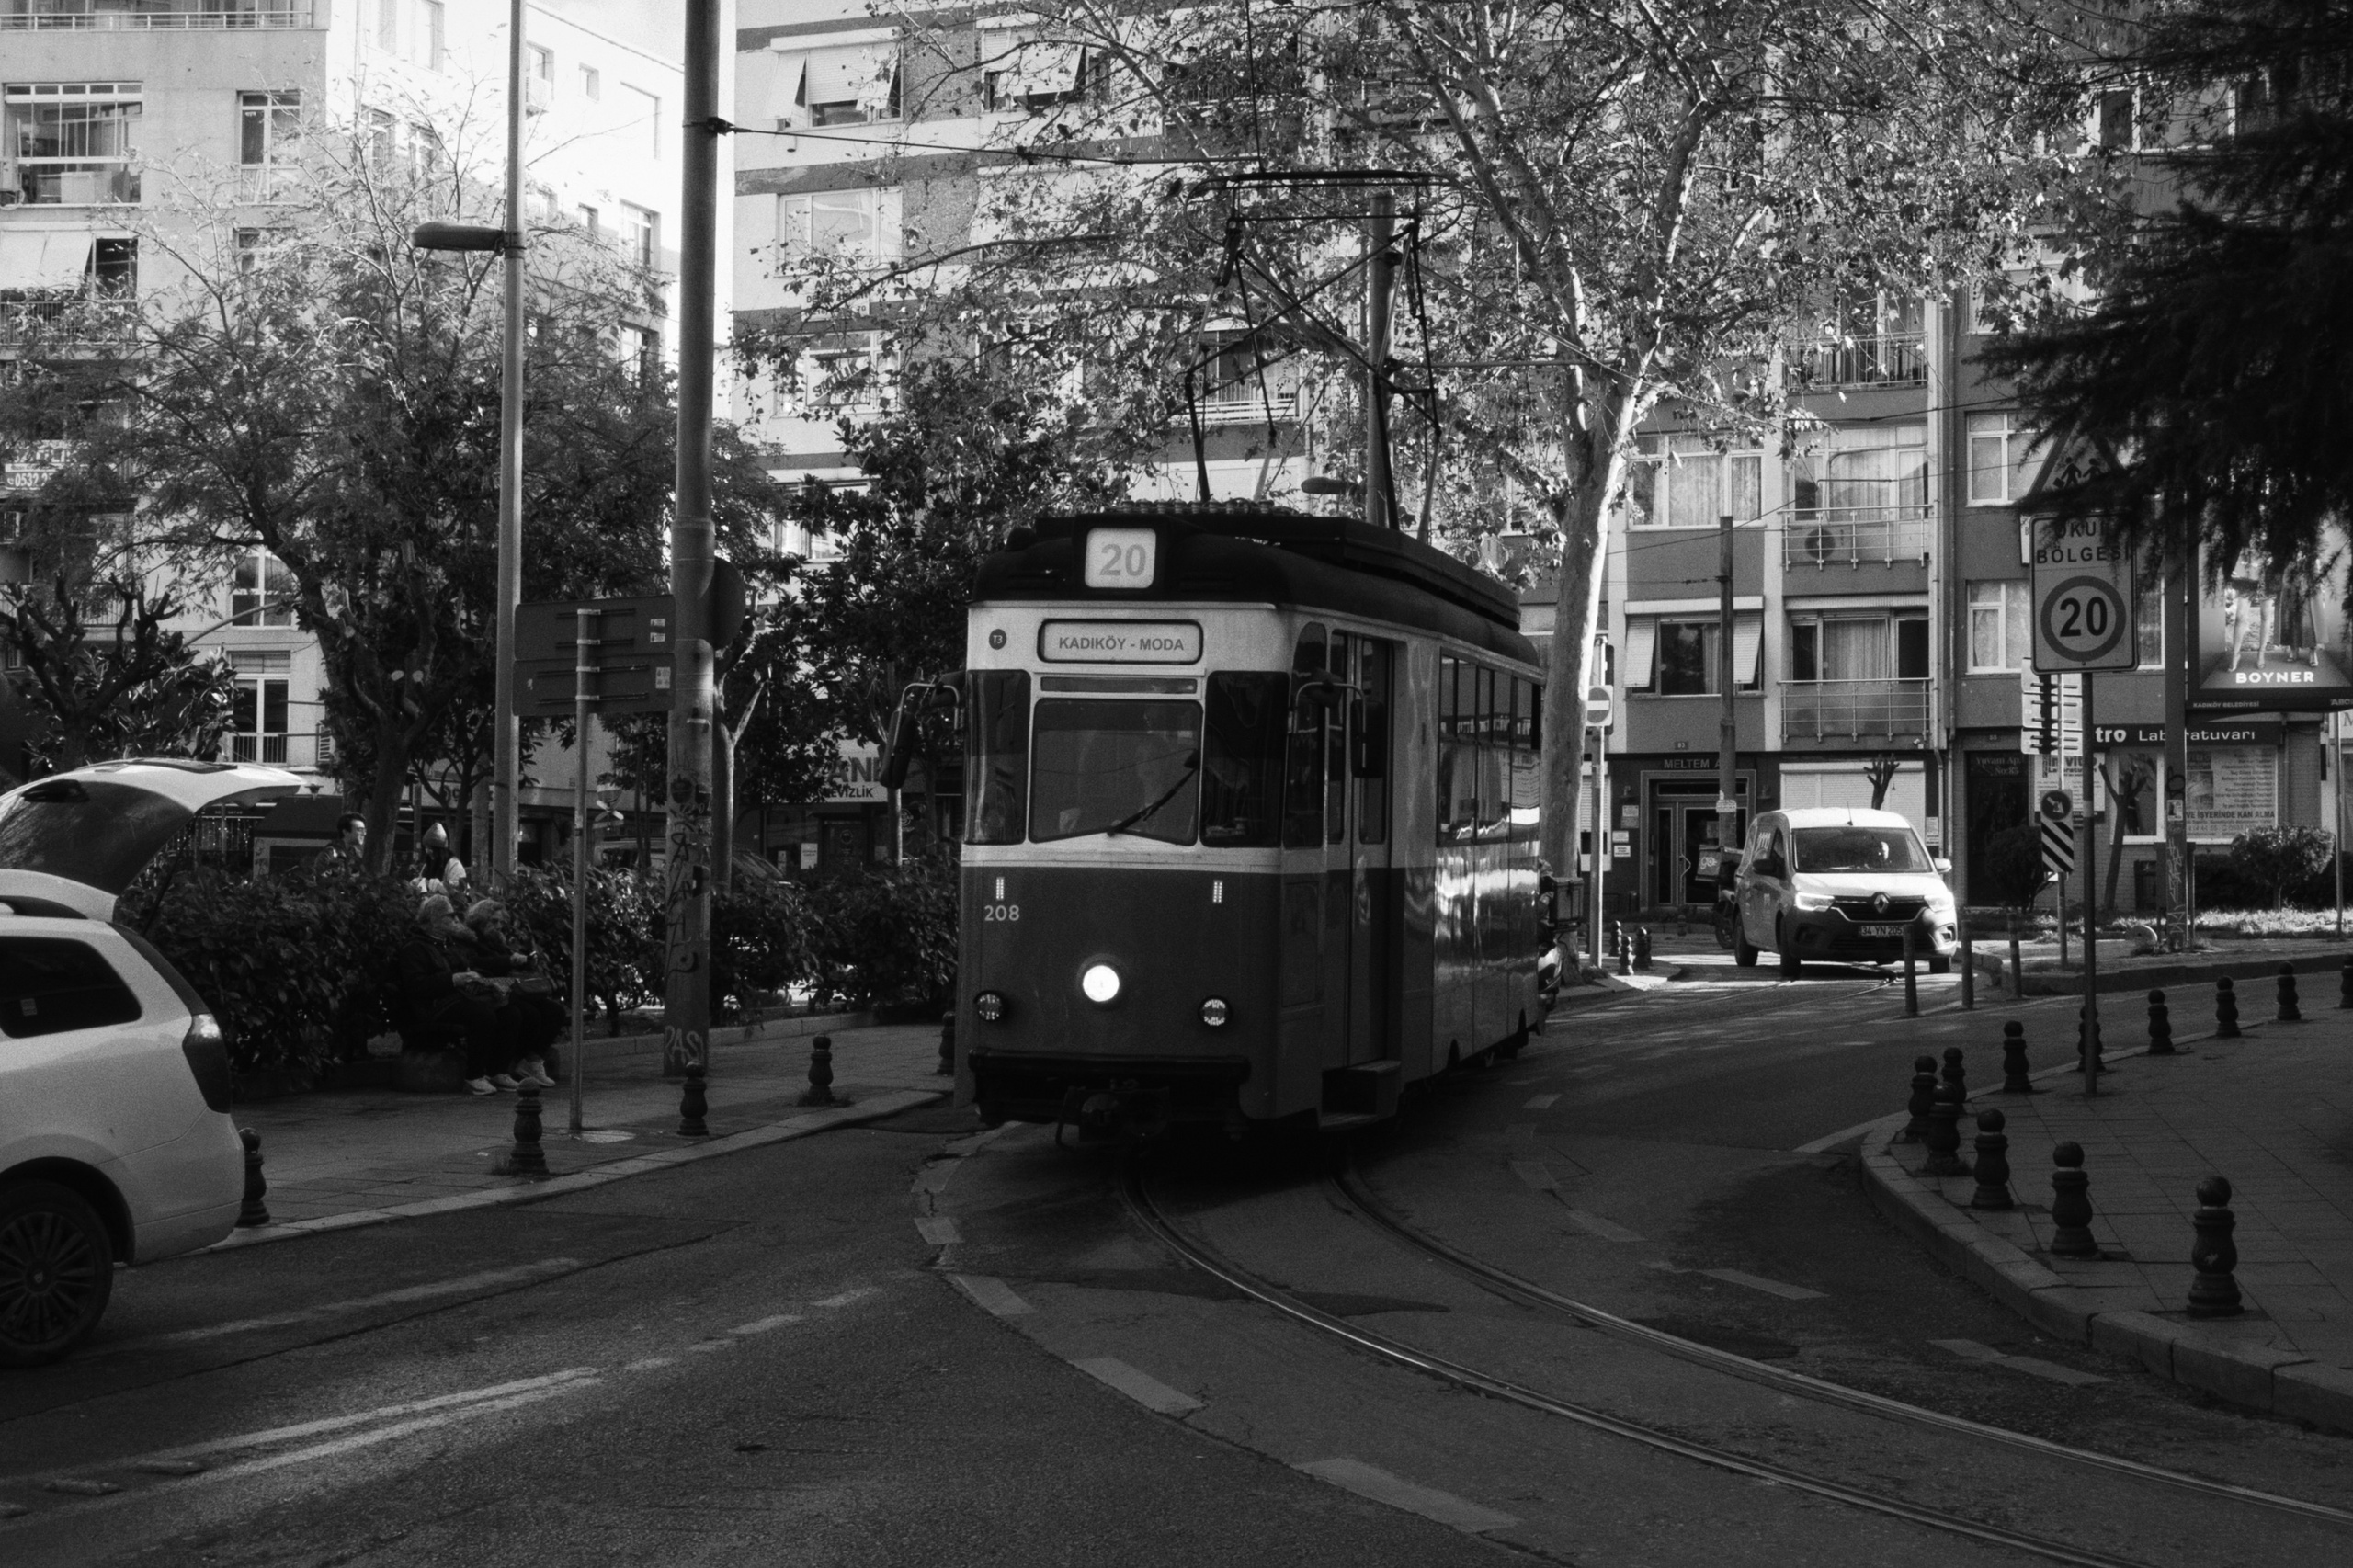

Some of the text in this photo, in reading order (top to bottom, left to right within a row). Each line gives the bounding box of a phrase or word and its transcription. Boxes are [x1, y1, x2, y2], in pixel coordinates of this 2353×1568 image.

[1099, 544, 1146, 576] 20
[2060, 597, 2108, 637] 20
[1059, 635, 1127, 651] KADIKÖY
[1139, 638, 1185, 651] MODA
[2235, 671, 2314, 684] BOYNER
[2139, 729, 2255, 742] Labratuvarı
[1664, 759, 1710, 769] MELTEM
[984, 905, 1020, 921] 208
[1862, 926, 1903, 935] 34 YN 205
